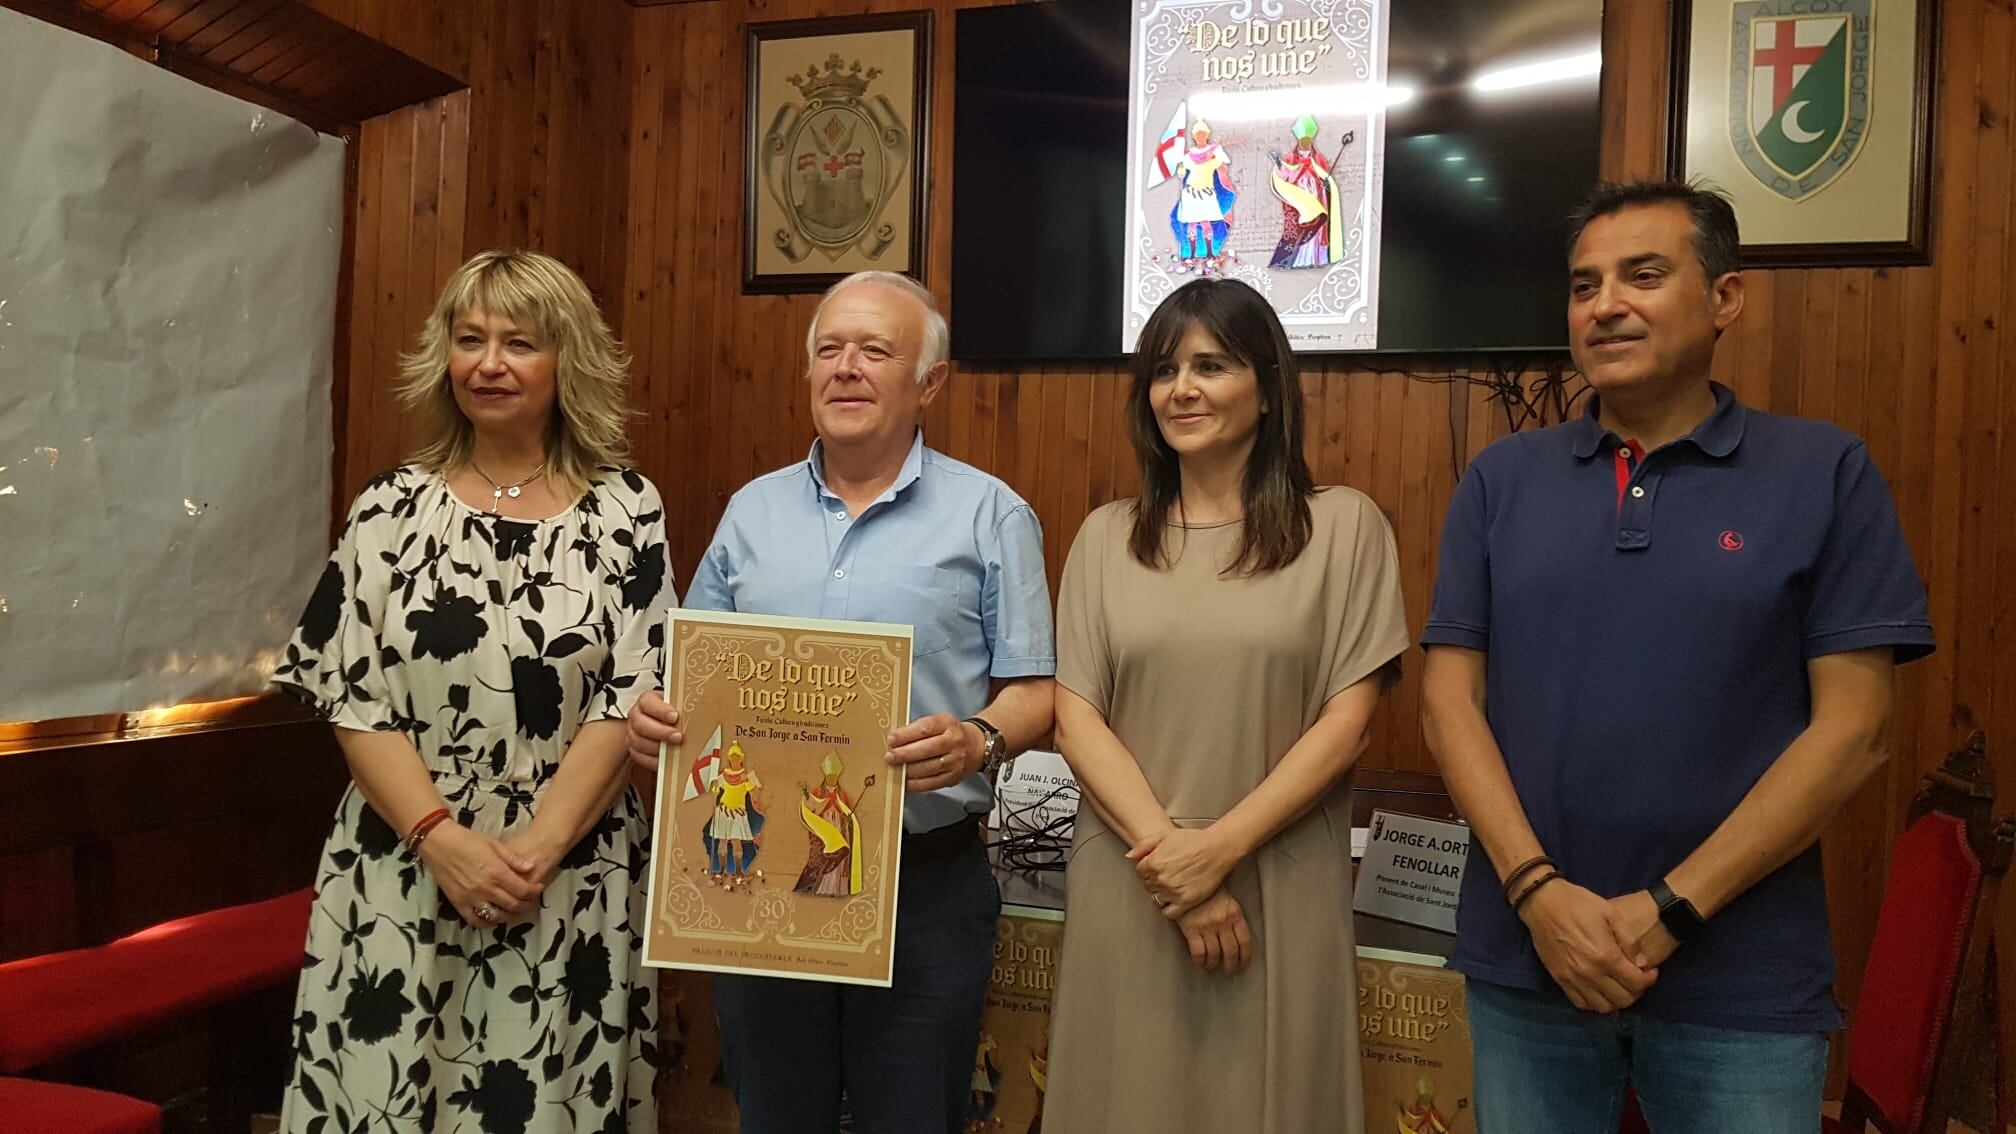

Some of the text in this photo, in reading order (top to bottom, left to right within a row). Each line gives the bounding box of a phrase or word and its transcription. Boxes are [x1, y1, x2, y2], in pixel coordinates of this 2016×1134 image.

[1753, 0, 1849, 17] ALCOY
[1244, 16, 1271, 47] lo
[1277, 17, 1332, 50] que
[1202, 50, 1256, 83] nos
[1771, 175, 1818, 193] DE
[1831, 118, 1866, 167] SAN
[1851, 15, 1869, 102] JORGE
[778, 655, 802, 685] lo
[807, 663, 857, 691] que
[738, 686, 788, 716] nos
[735, 725, 749, 737] De
[749, 726, 766, 738] San
[769, 728, 790, 742] Jorge
[793, 731, 799, 740] a
[800, 730, 818, 742] San
[1019, 773, 1042, 782] JUAN
[1042, 776, 1049, 784] J.
[1383, 829, 1425, 848] JORGE
[1392, 854, 1460, 880] FENOLLAR
[760, 899, 785, 919] 30
[1009, 939, 1028, 963] lo
[1375, 984, 1396, 1011] lo
[1402, 993, 1448, 1018] que
